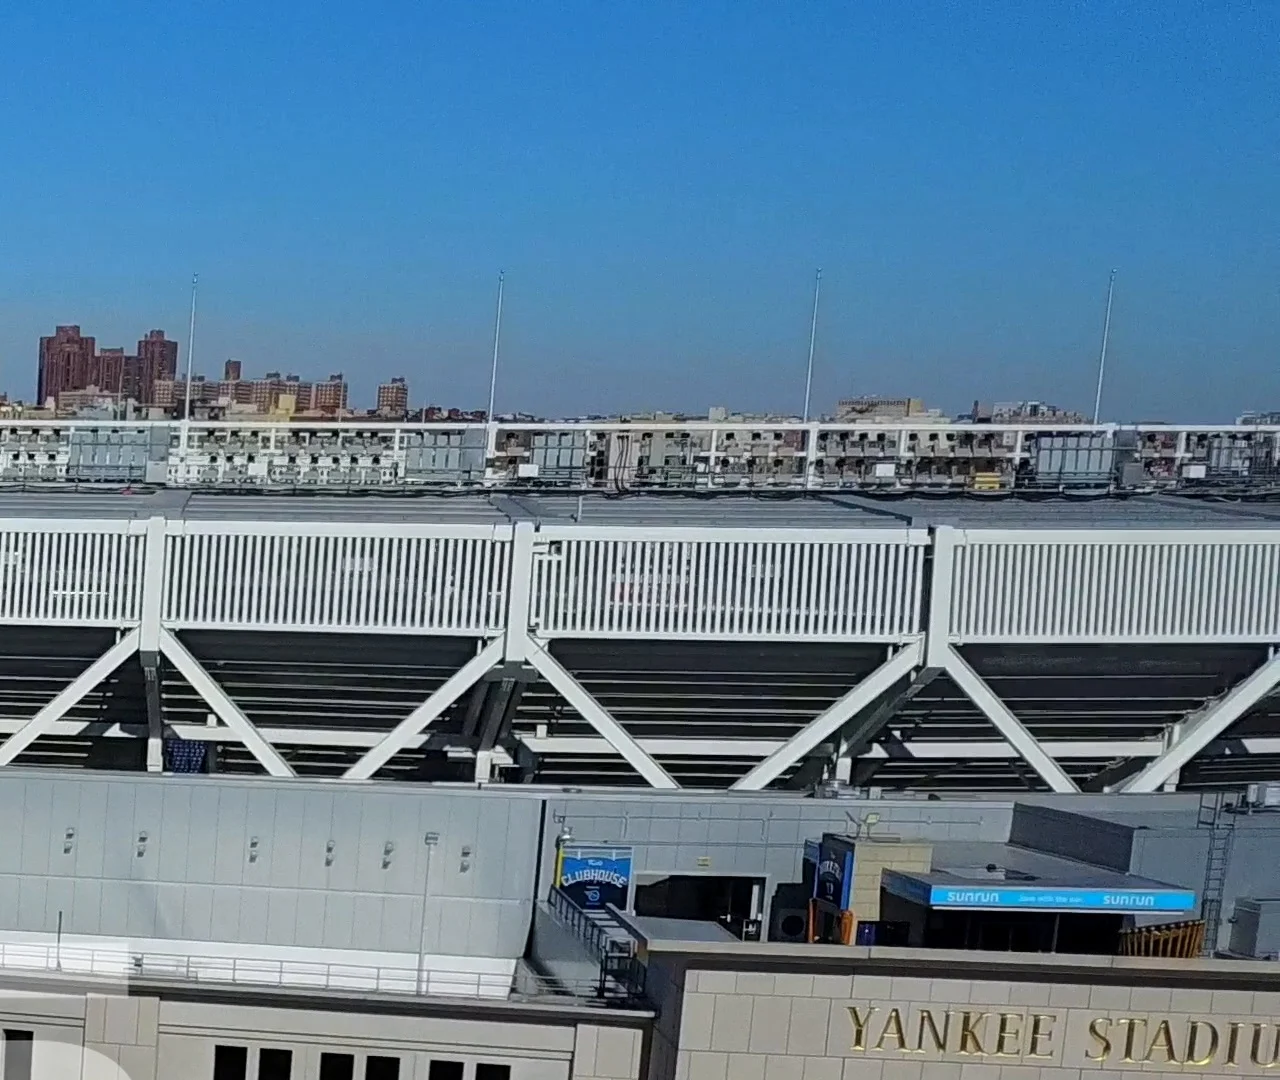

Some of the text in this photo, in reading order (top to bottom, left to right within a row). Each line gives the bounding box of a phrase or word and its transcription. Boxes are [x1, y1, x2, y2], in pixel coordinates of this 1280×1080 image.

[561, 869, 628, 888] CLUBHOUSE
[947, 890, 1000, 903] sunrun
[1102, 894, 1155, 907] sunrun
[844, 1006, 1058, 1058] YANKEE
